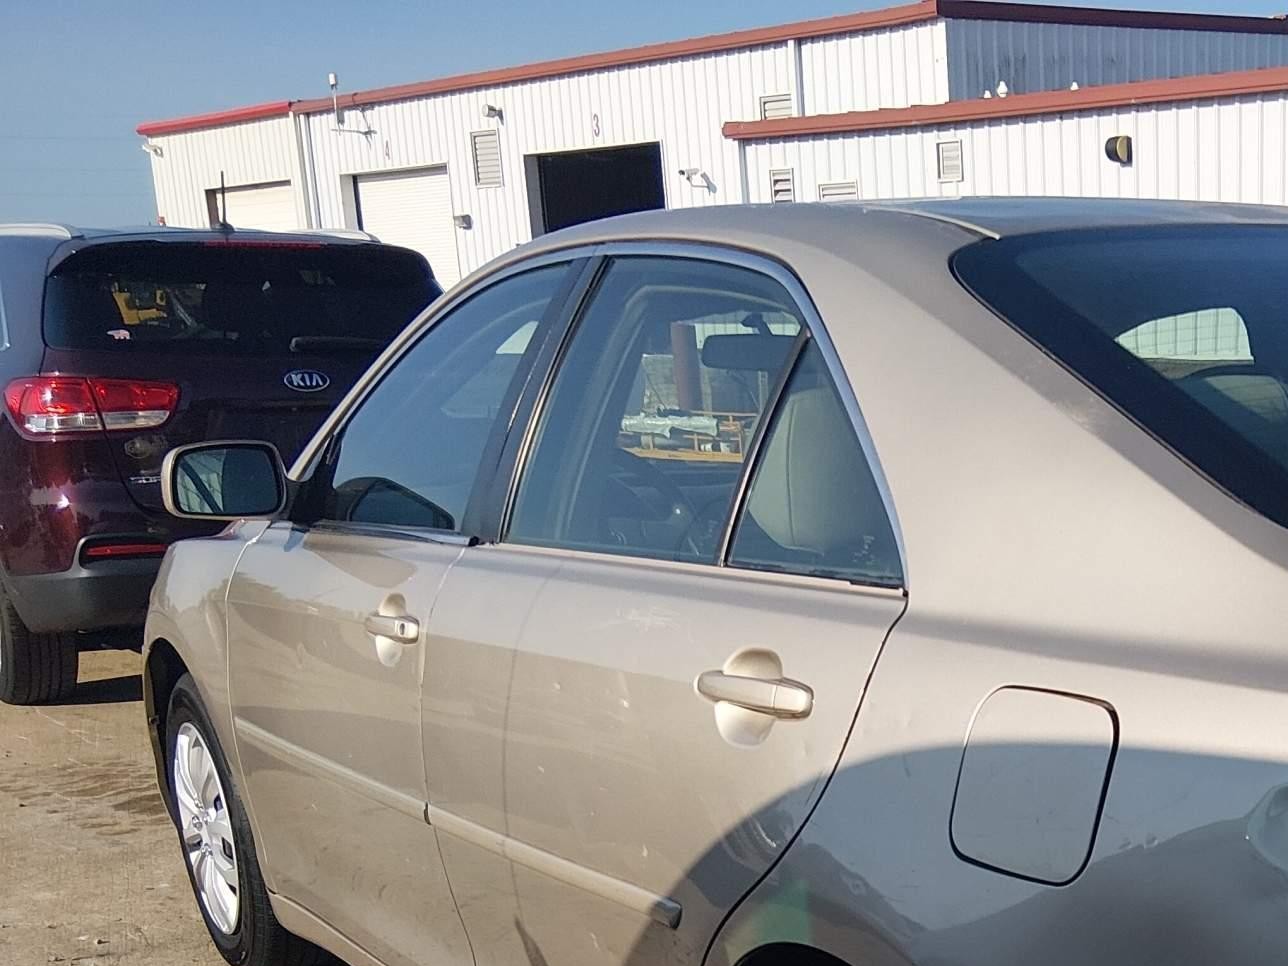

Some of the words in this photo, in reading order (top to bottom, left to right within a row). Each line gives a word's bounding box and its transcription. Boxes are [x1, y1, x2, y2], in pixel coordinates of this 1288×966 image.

[593, 114, 600, 137] 3
[385, 140, 391, 160] 4
[291, 373, 324, 386] KIA
